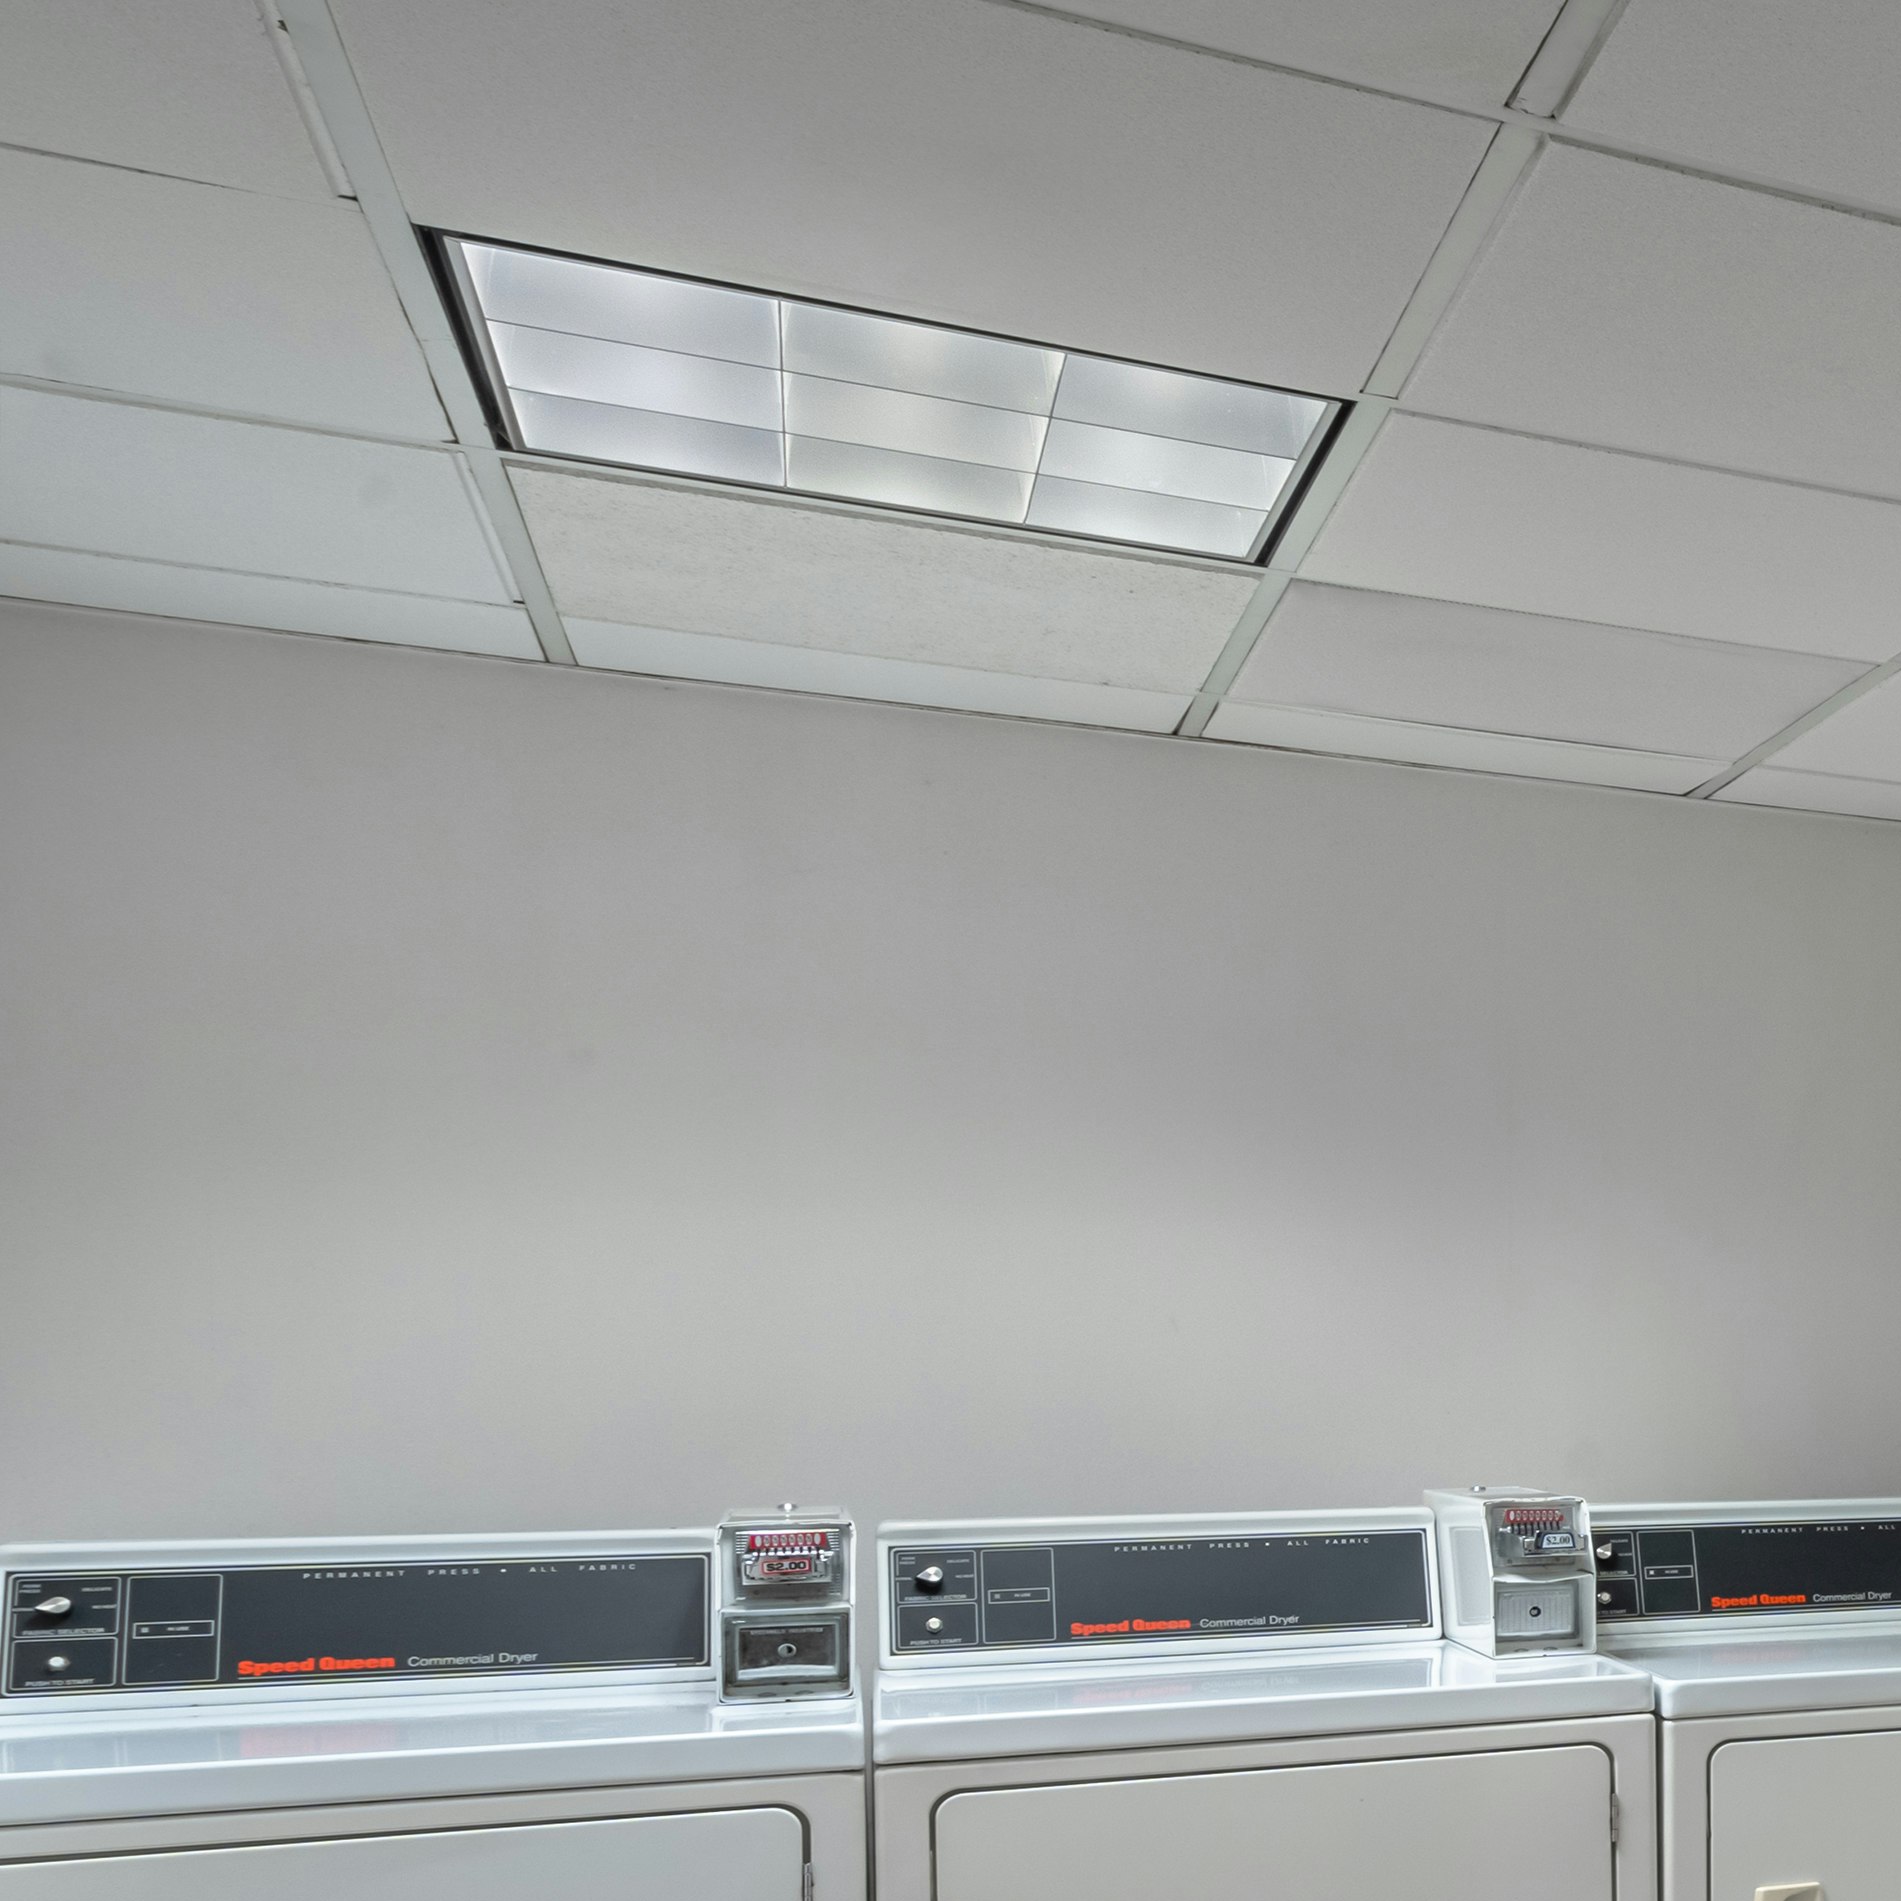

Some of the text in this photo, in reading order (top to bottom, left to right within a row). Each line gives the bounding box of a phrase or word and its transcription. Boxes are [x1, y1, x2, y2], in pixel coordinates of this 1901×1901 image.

[1114, 1544, 1192, 1552] PERMANENT
[303, 1570, 405, 1579] PERMANENT
[579, 1563, 636, 1571] FABRIC
[1711, 1592, 1892, 1608] Speed Queen Commercial Dryer
[1071, 1615, 1300, 1635] Speed Queen Commercial Dryer
[238, 1652, 538, 1676] Speed Queen Commercial Dryer
